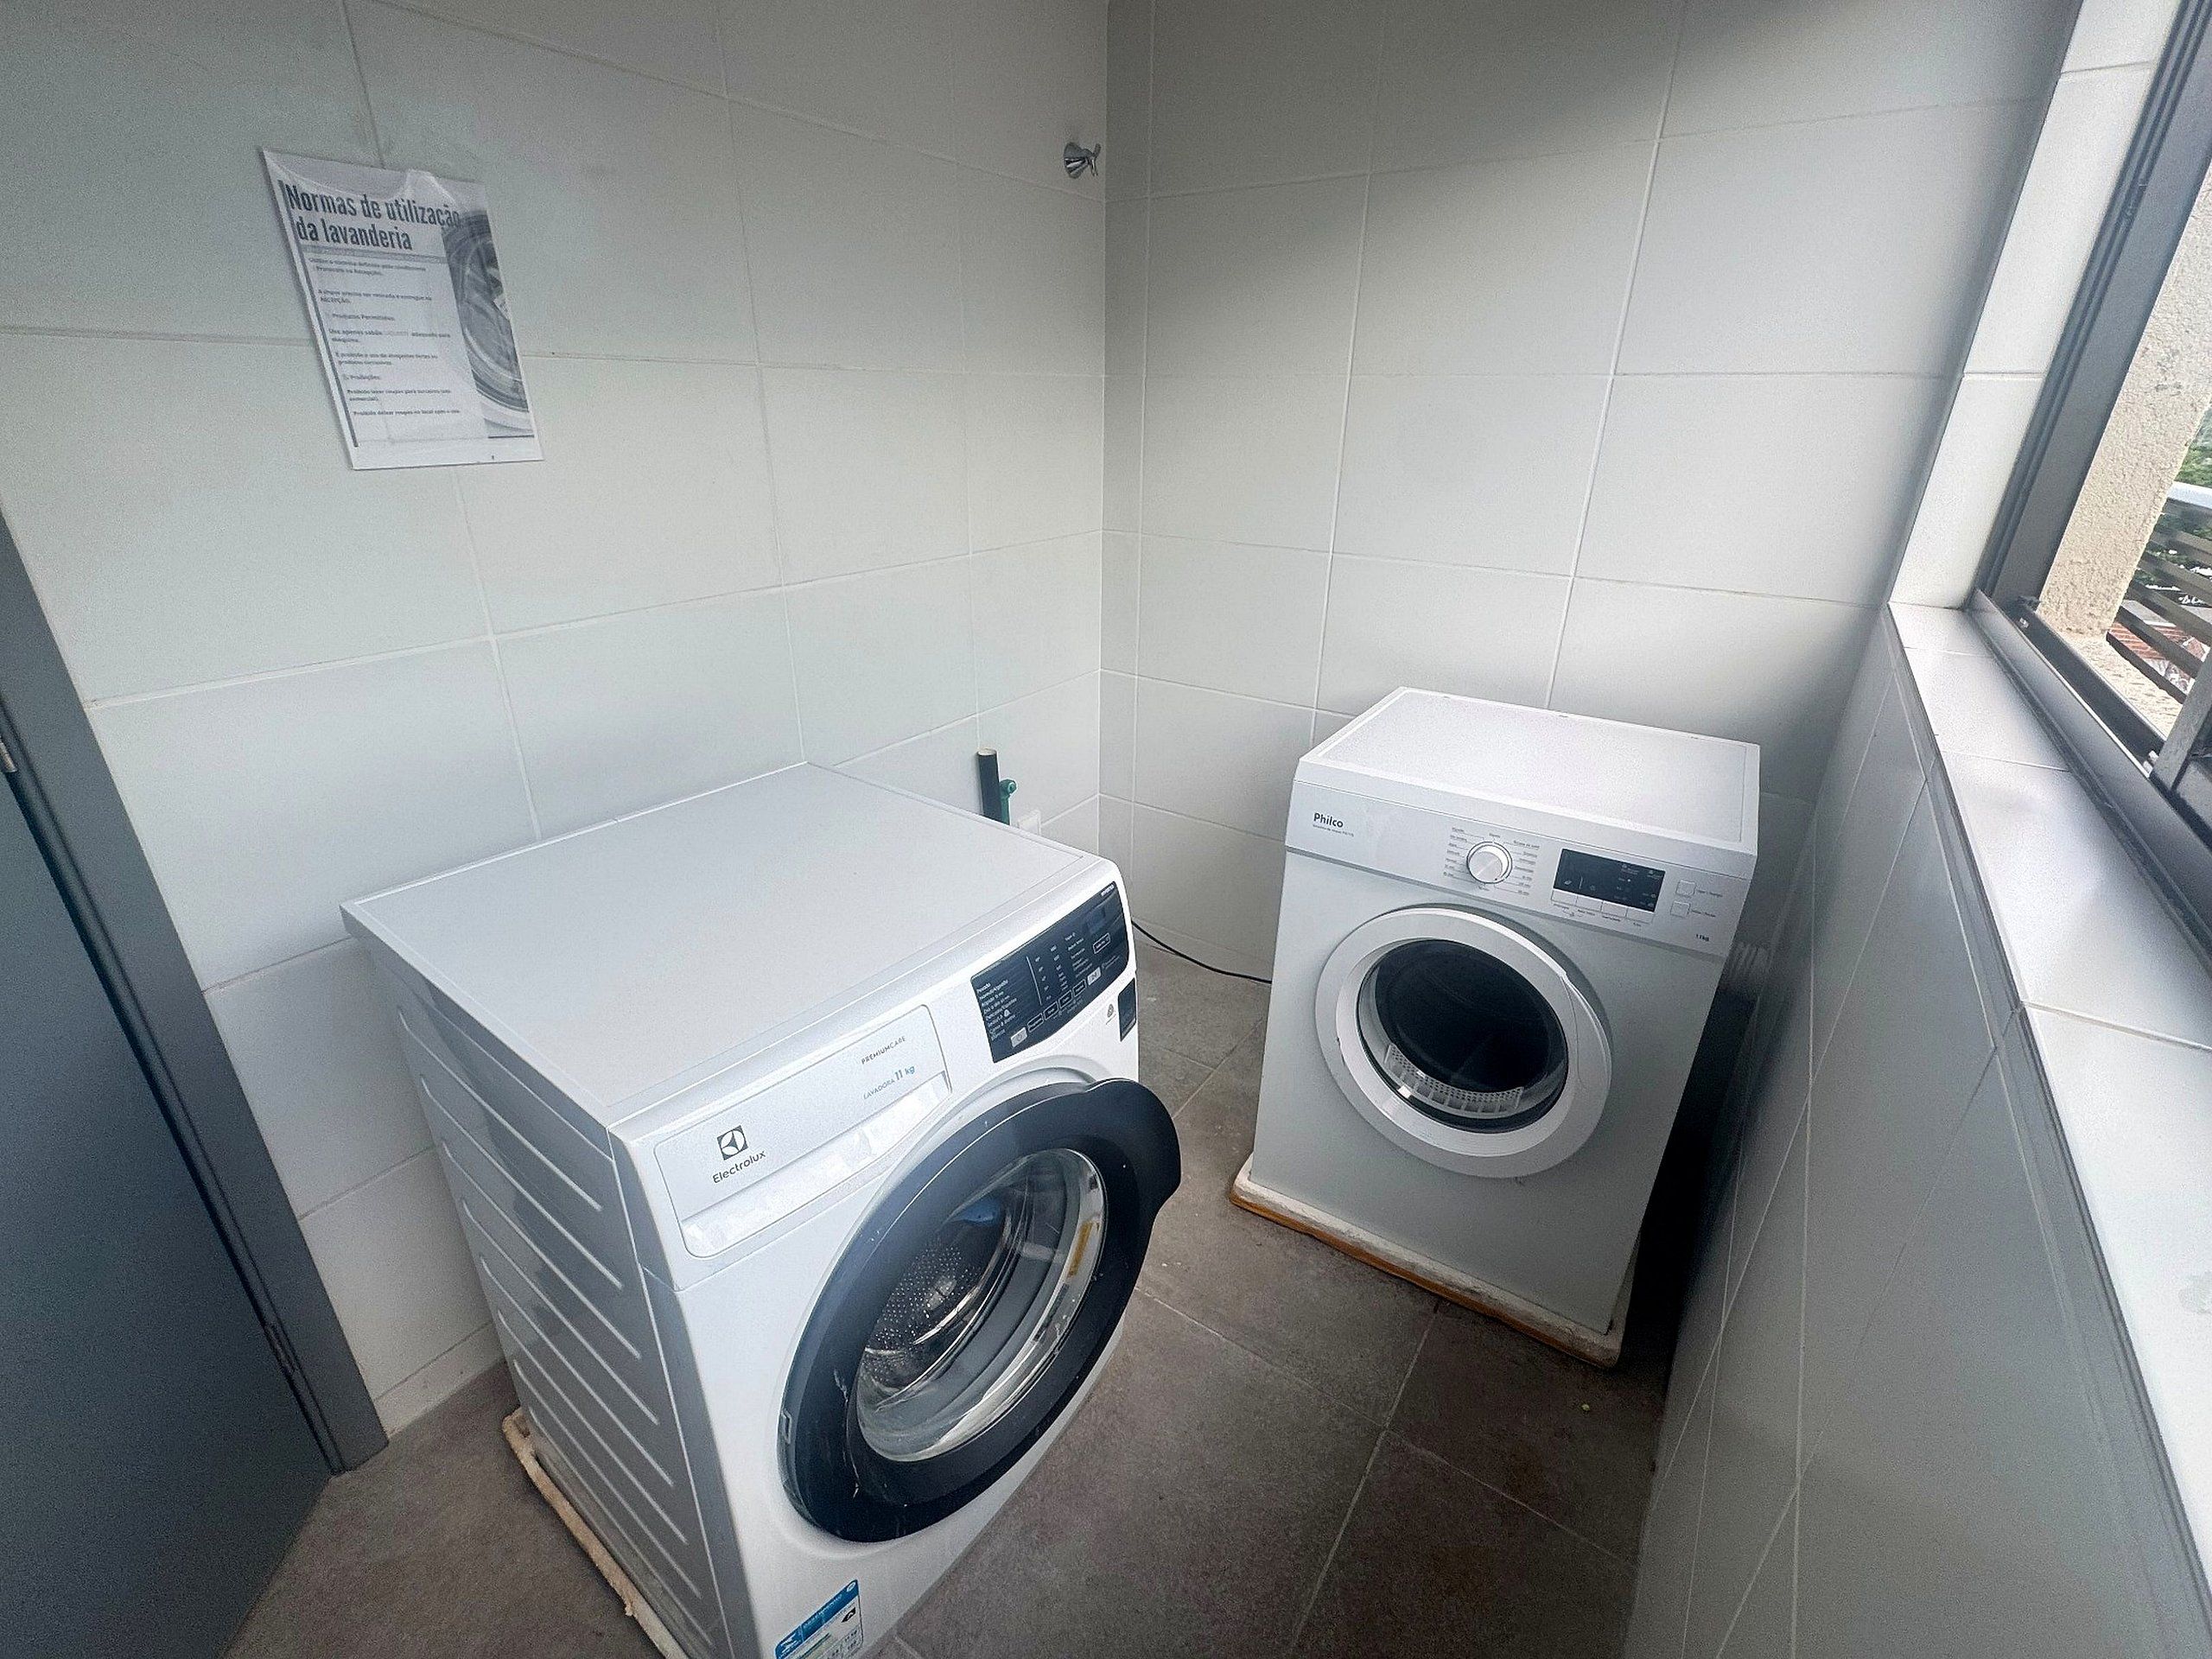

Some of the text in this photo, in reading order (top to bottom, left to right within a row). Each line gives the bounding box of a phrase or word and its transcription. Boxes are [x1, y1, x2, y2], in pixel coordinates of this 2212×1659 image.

[285, 183, 357, 217] Normas
[361, 194, 382, 219] de
[296, 216, 413, 251] da lavanderia
[1313, 812, 1344, 828] Philco
[861, 1035, 906, 1065] PREMIUMCARE
[863, 1065, 915, 1100] LAVADORA 11 kg
[713, 1150, 766, 1184] Electrolux
